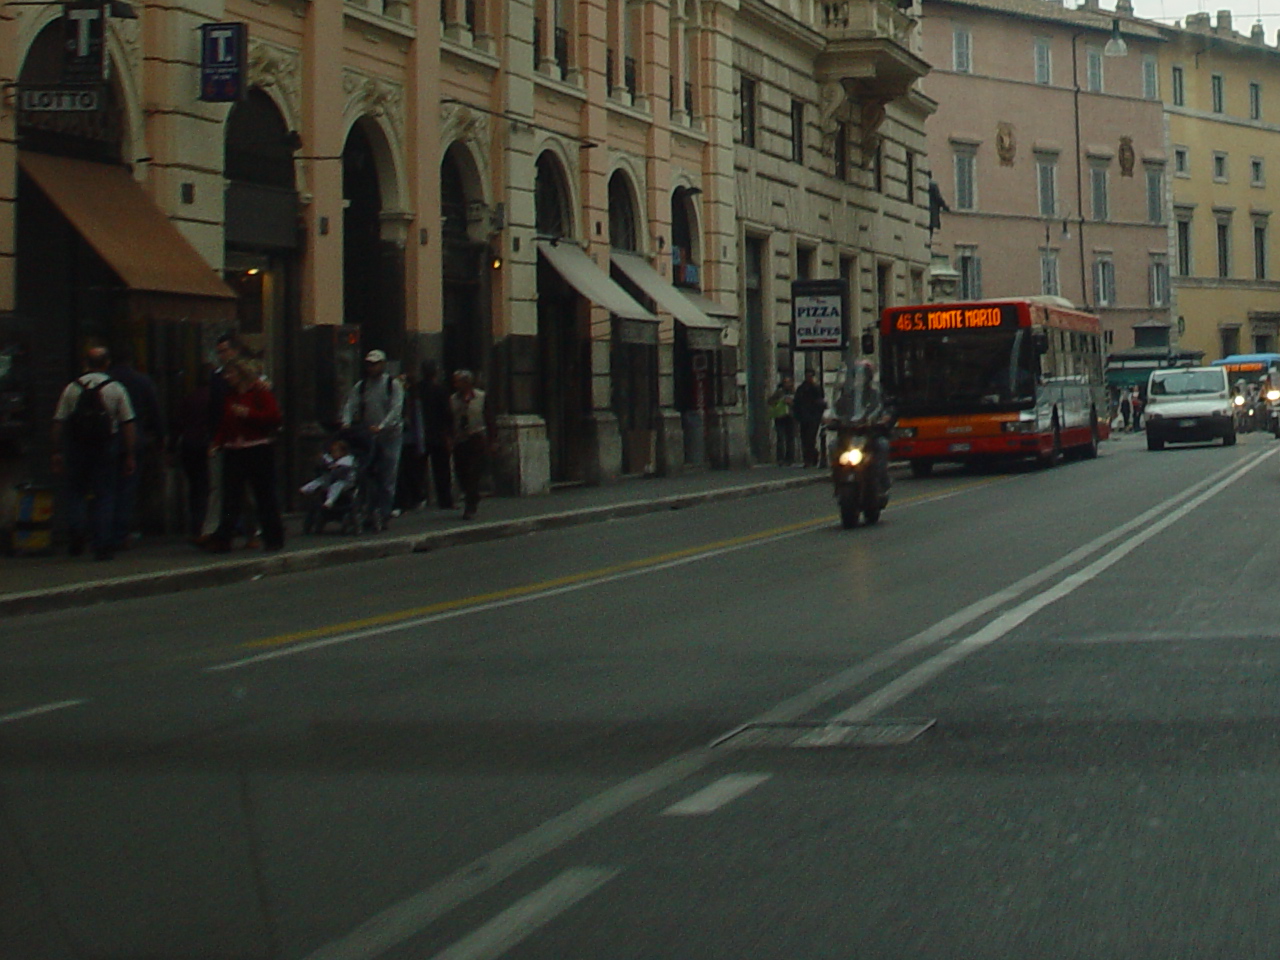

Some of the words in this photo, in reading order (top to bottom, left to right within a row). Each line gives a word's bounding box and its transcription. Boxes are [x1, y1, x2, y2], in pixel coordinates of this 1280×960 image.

[68, 9, 100, 57] T
[26, 92, 94, 108] LOTTO
[797, 306, 840, 317] PIZZA
[896, 313, 912, 331] 46
[928, 310, 963, 330] MONTE
[965, 307, 1001, 328] MARIO
